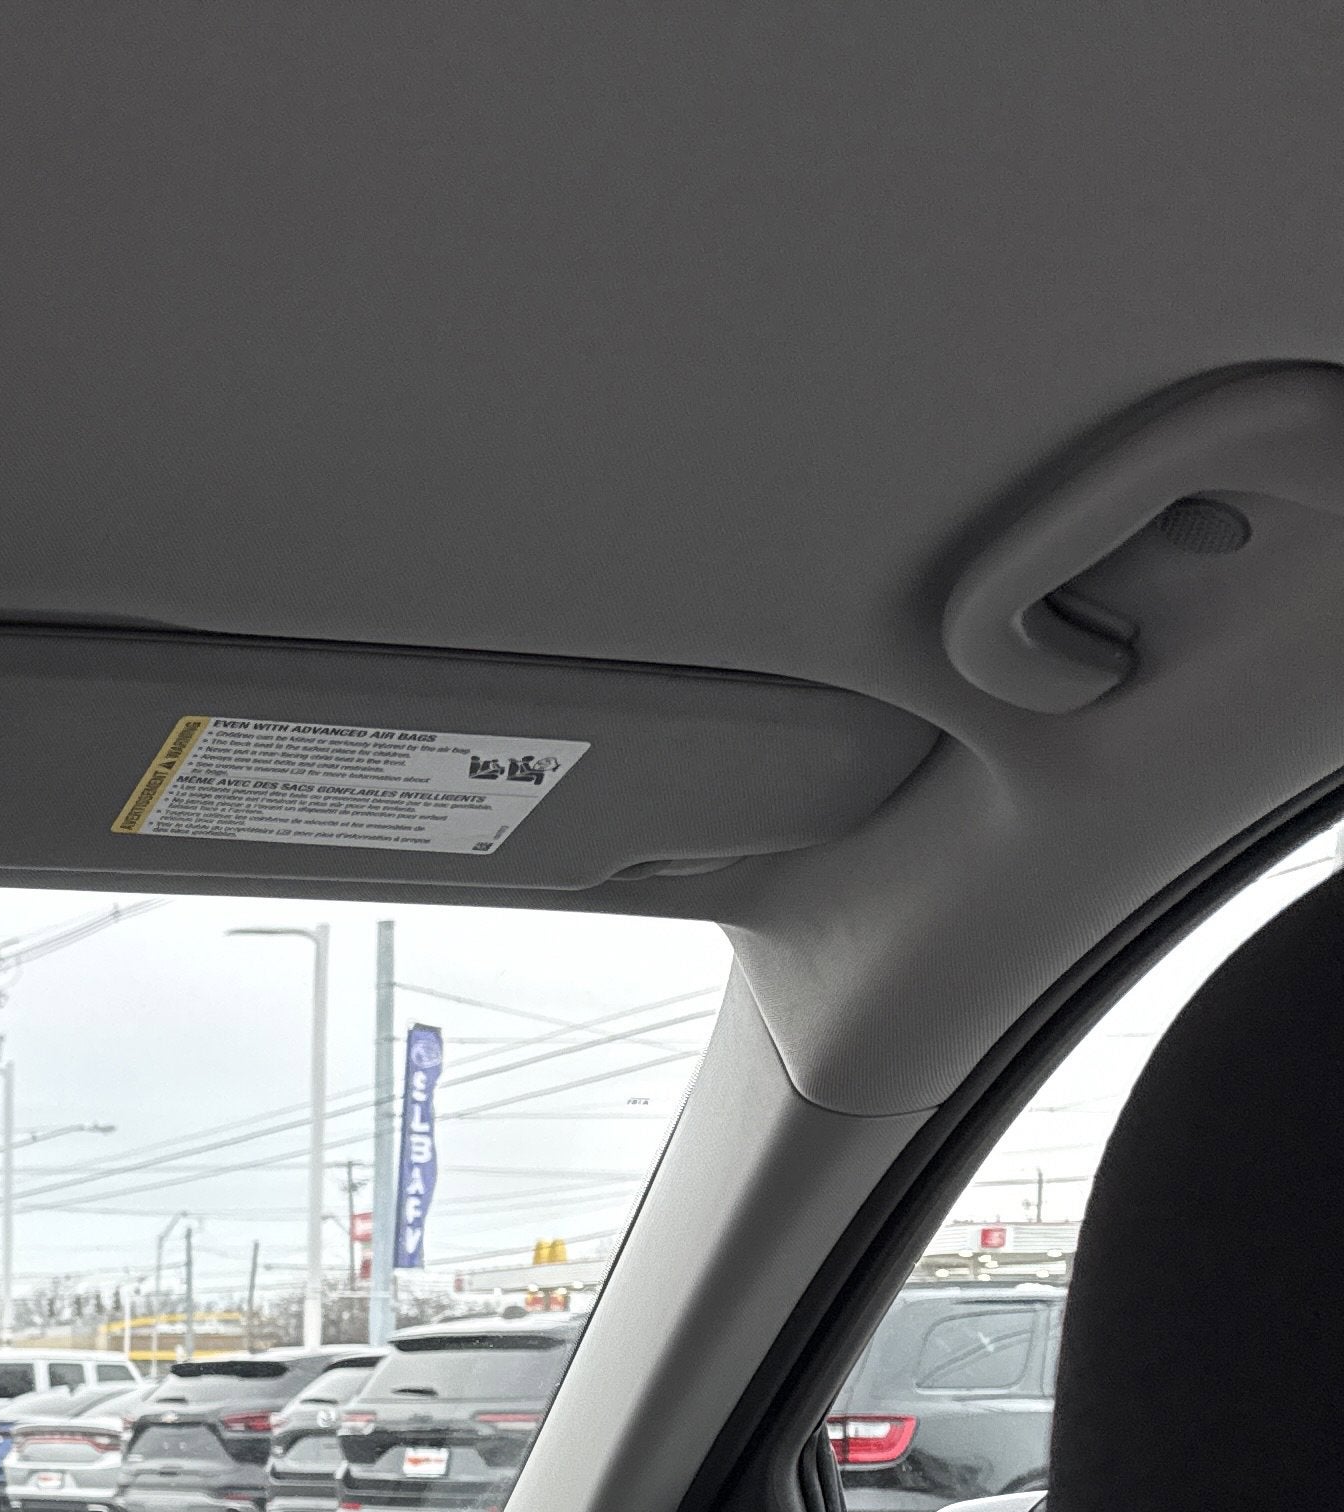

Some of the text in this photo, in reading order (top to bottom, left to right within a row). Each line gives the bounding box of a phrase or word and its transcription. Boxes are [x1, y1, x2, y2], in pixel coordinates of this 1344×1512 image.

[165, 721, 202, 759] WARNING
[212, 719, 438, 743] EVEN WITH ADVANCED AIR BAGS
[217, 778, 252, 787] AVEC
[253, 780, 278, 790] DES
[280, 782, 315, 792] SACS
[317, 785, 398, 798] GONFLABLES
[399, 791, 487, 803] INTELLIGENTS
